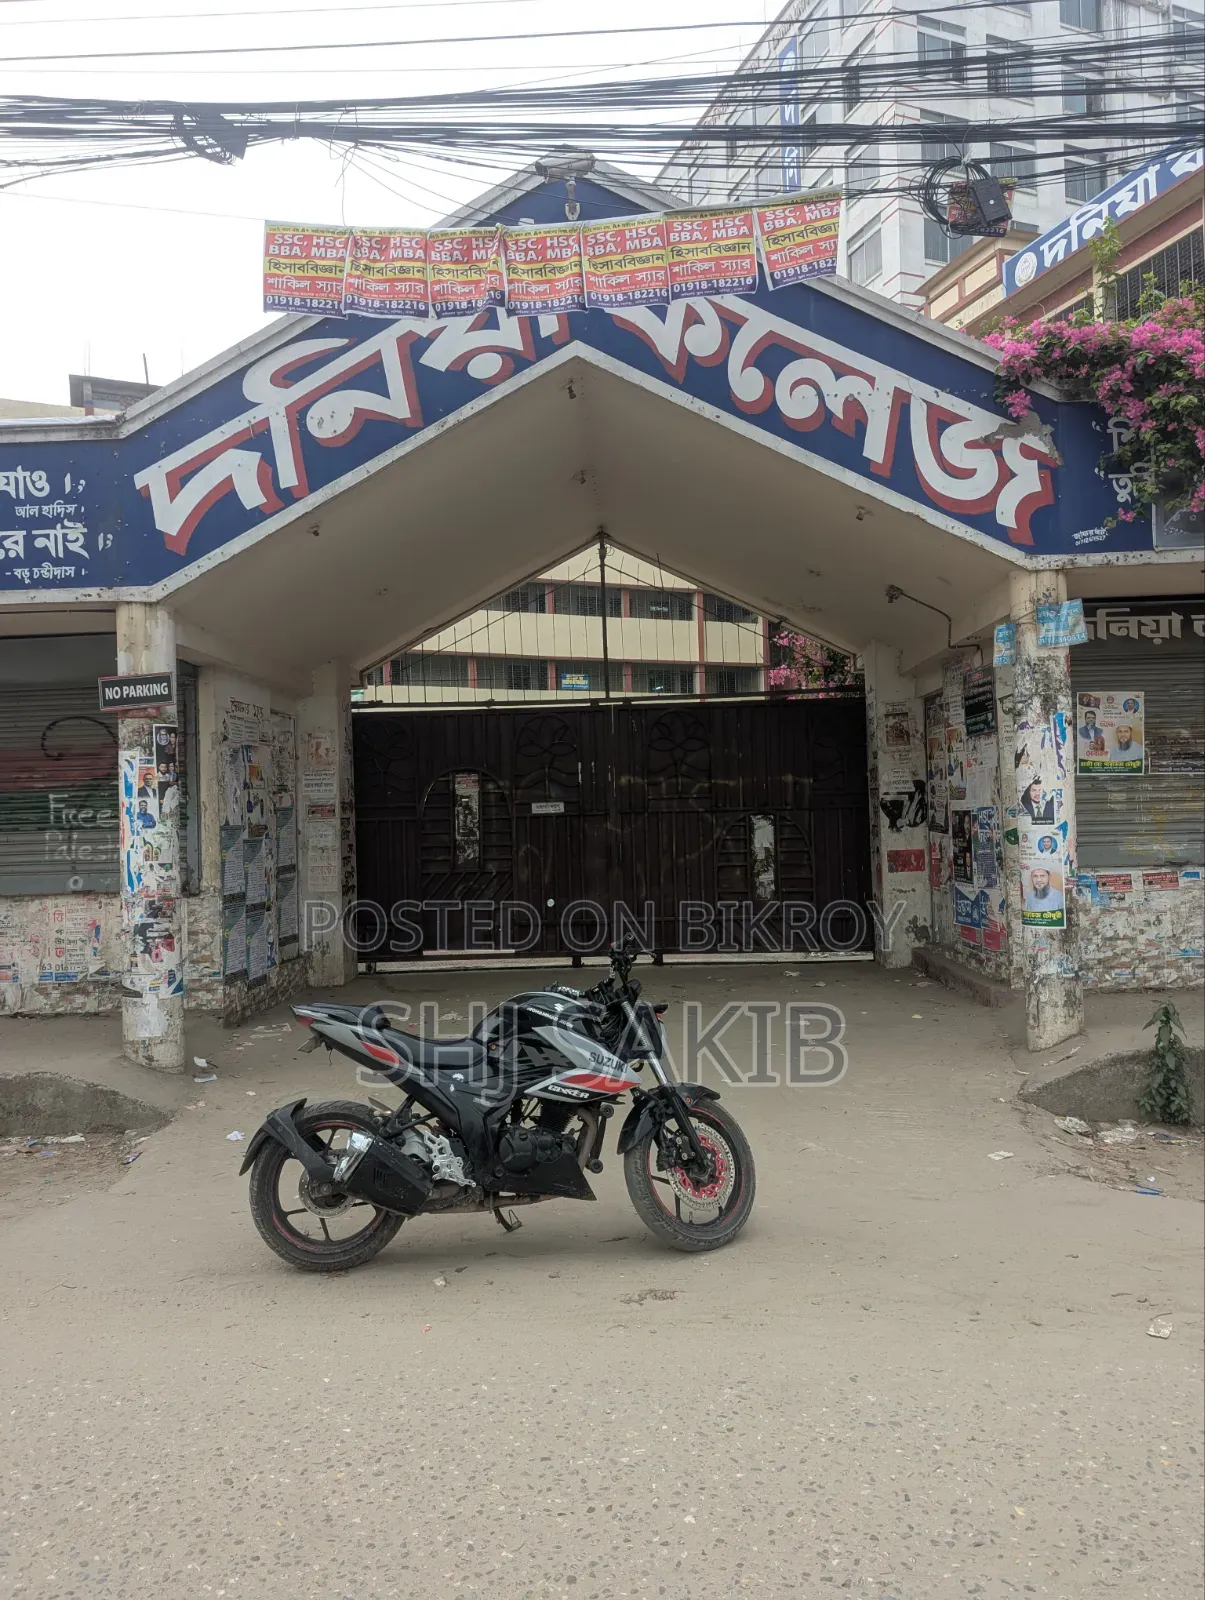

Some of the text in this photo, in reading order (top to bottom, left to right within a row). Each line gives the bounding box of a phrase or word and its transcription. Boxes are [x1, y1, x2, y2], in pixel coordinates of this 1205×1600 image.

[762, 205, 841, 232] BBA, MBA
[765, 207, 800, 220] SSC,
[673, 220, 708, 232] SSC,
[711, 215, 745, 229] HSC
[274, 234, 345, 248] SSC, HSC
[390, 237, 421, 248] HSC
[586, 231, 622, 246] SSC,
[625, 225, 658, 239] HSC
[669, 225, 750, 243] BBA, MBA
[269, 245, 347, 258] BBA, MBA
[434, 238, 468, 251] SSC,
[506, 243, 580, 262] BBA, MBA
[507, 236, 576, 251] SSC, HSC
[625, 236, 663, 251] MBA
[669, 241, 753, 260] হিসাববিজ্ঞান
[389, 248, 425, 259] MBA
[430, 250, 468, 263] BBA,
[768, 244, 815, 264] শাকিল
[350, 259, 427, 277] হিসাববিজ্ঞান
[587, 253, 665, 273] হিসাববিজ্ঞান
[670, 260, 716, 276] শাকিল
[719, 258, 752, 271] স্যার
[266, 275, 311, 292] শাকিল
[347, 277, 391, 294] শাকিল
[394, 282, 425, 295] স্যার
[432, 281, 476, 295] শাকিল
[507, 281, 551, 295] শাকিল
[554, 276, 583, 291] স্যার
[587, 273, 631, 288] শাকিল
[634, 270, 665, 283] স্যার
[673, 276, 753, 293] 01918-182216
[346, 294, 426, 311] 01918-182216
[508, 294, 585, 310] 01918-182216
[590, 288, 668, 302] 01918-182216
[602, 292, 1055, 545] কলেজ
[15, 504, 39, 518] আল
[42, 500, 78, 518] হাদিস
[32, 518, 90, 560] নাই
[105, 682, 169, 700] NO PARKING
[48, 793, 112, 827] Free
[588, 1051, 628, 1074] SUZUKI
